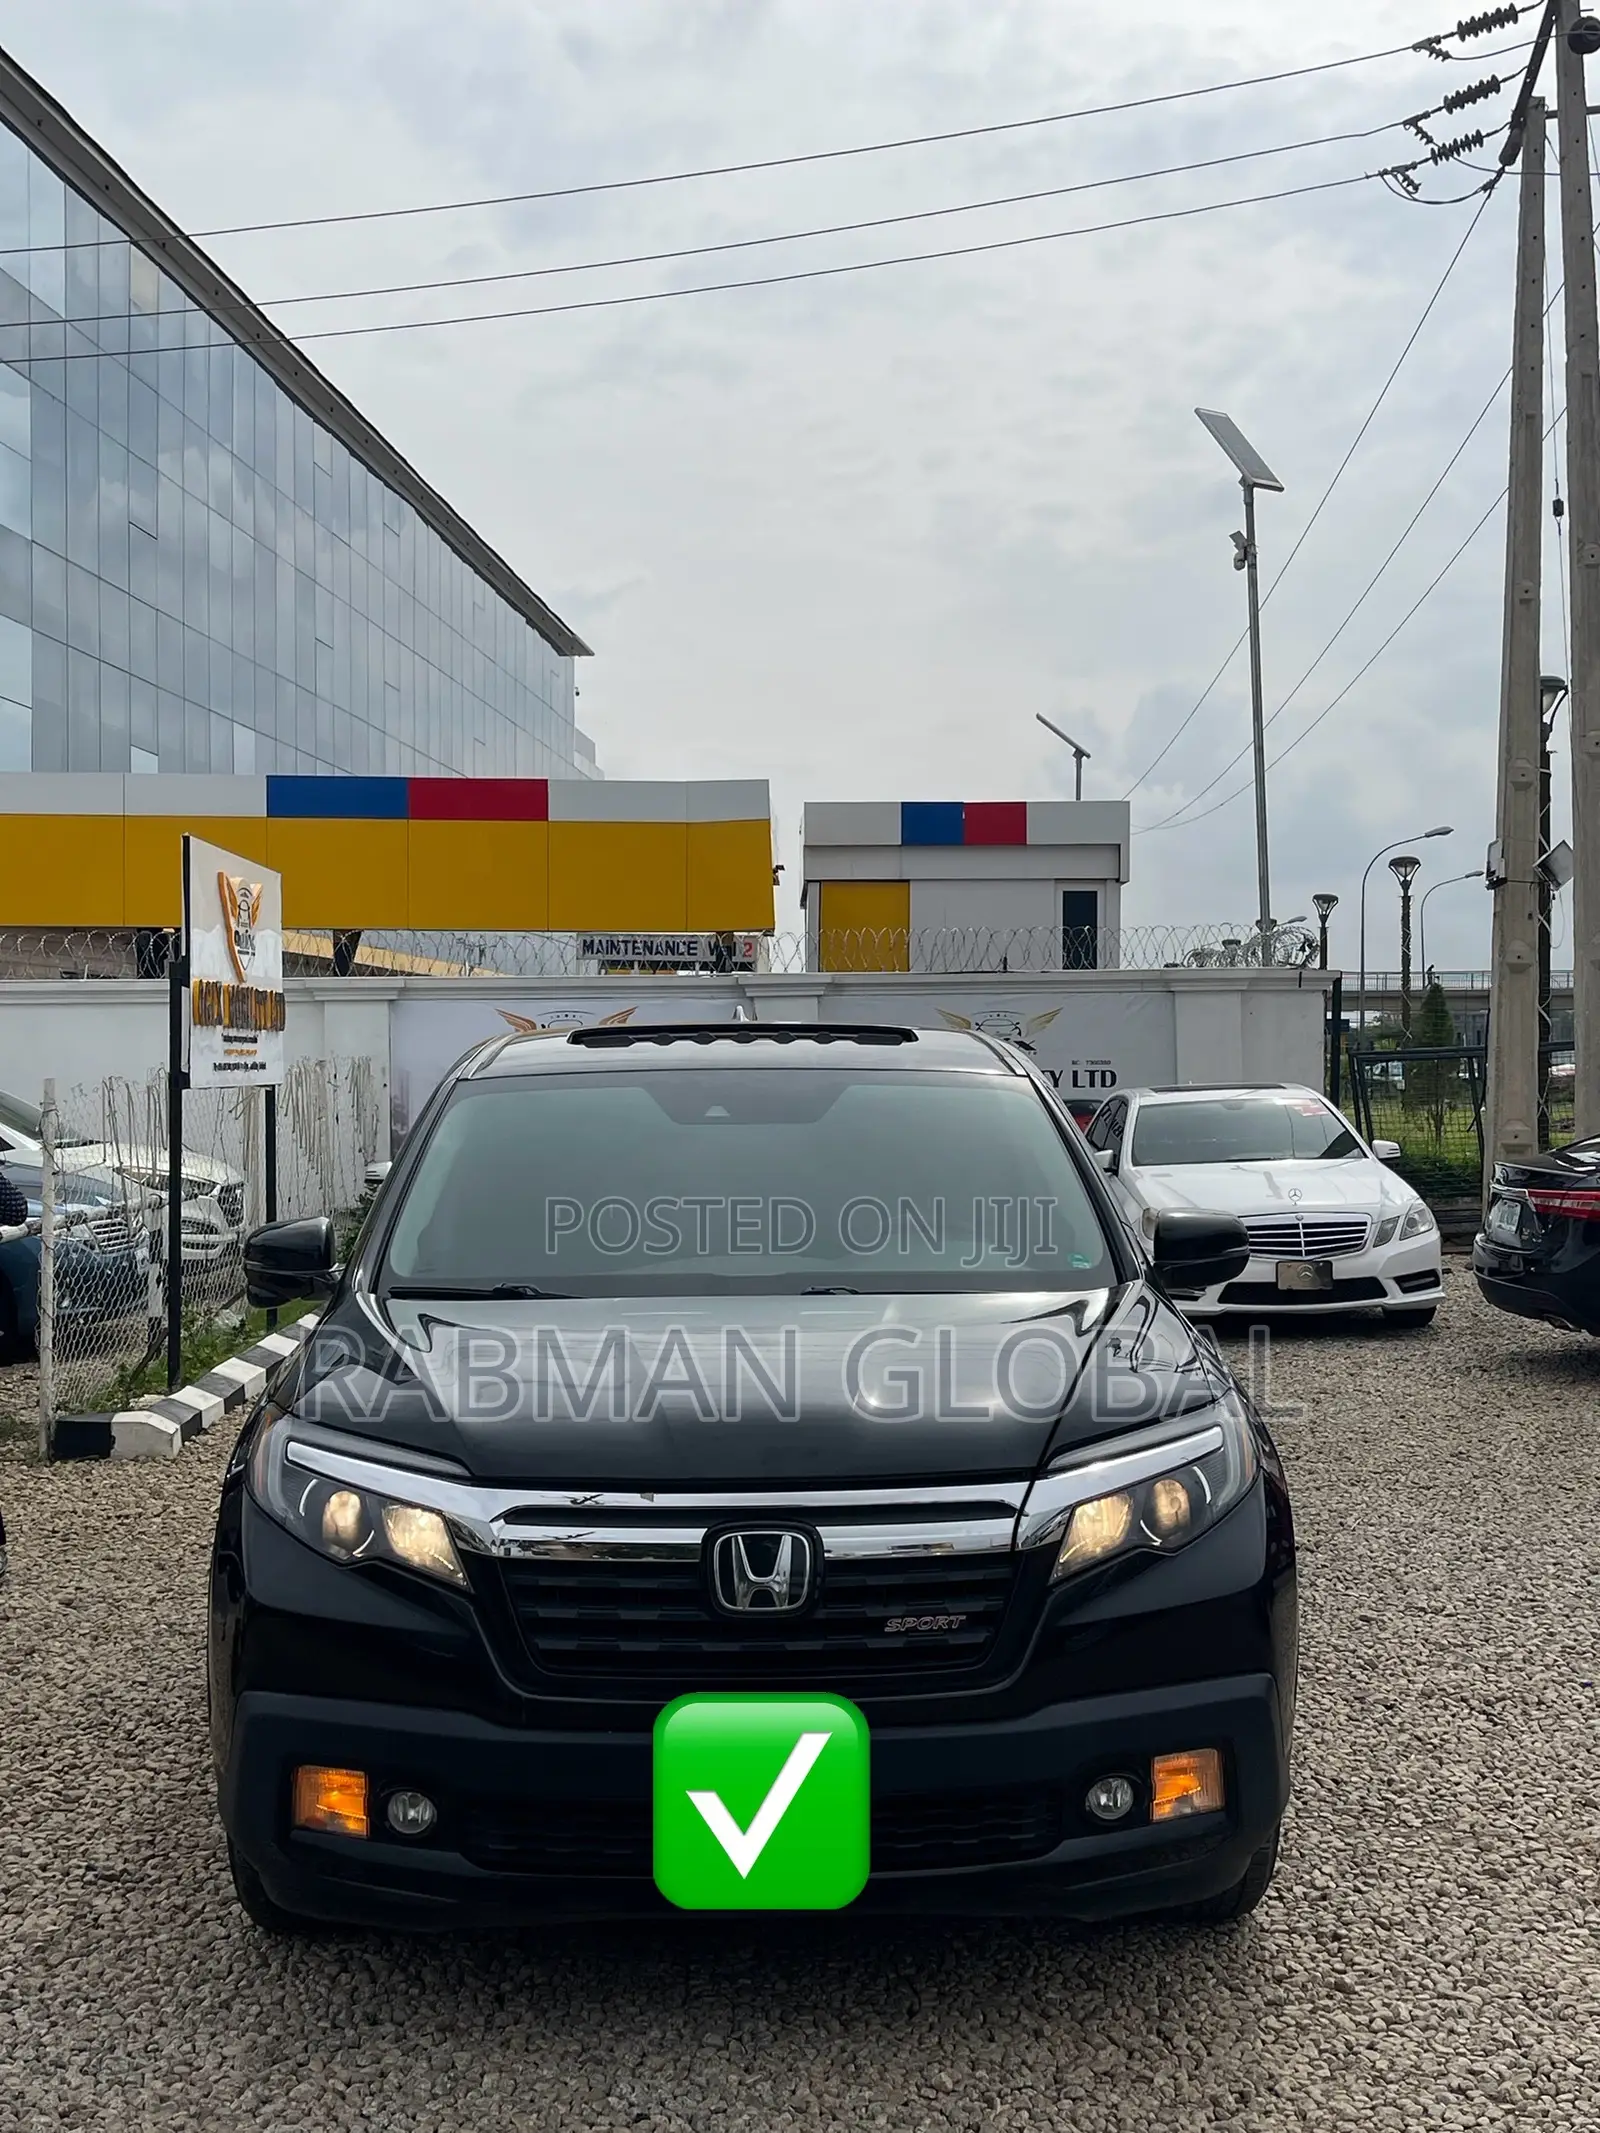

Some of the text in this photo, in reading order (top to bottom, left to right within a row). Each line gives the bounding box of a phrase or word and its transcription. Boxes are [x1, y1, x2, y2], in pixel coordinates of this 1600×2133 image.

[582, 938, 698, 957] MAINTENANCE
[744, 941, 754, 957] 2
[1072, 1070, 1117, 1088] LTD
[884, 1615, 967, 1632] SPORT
